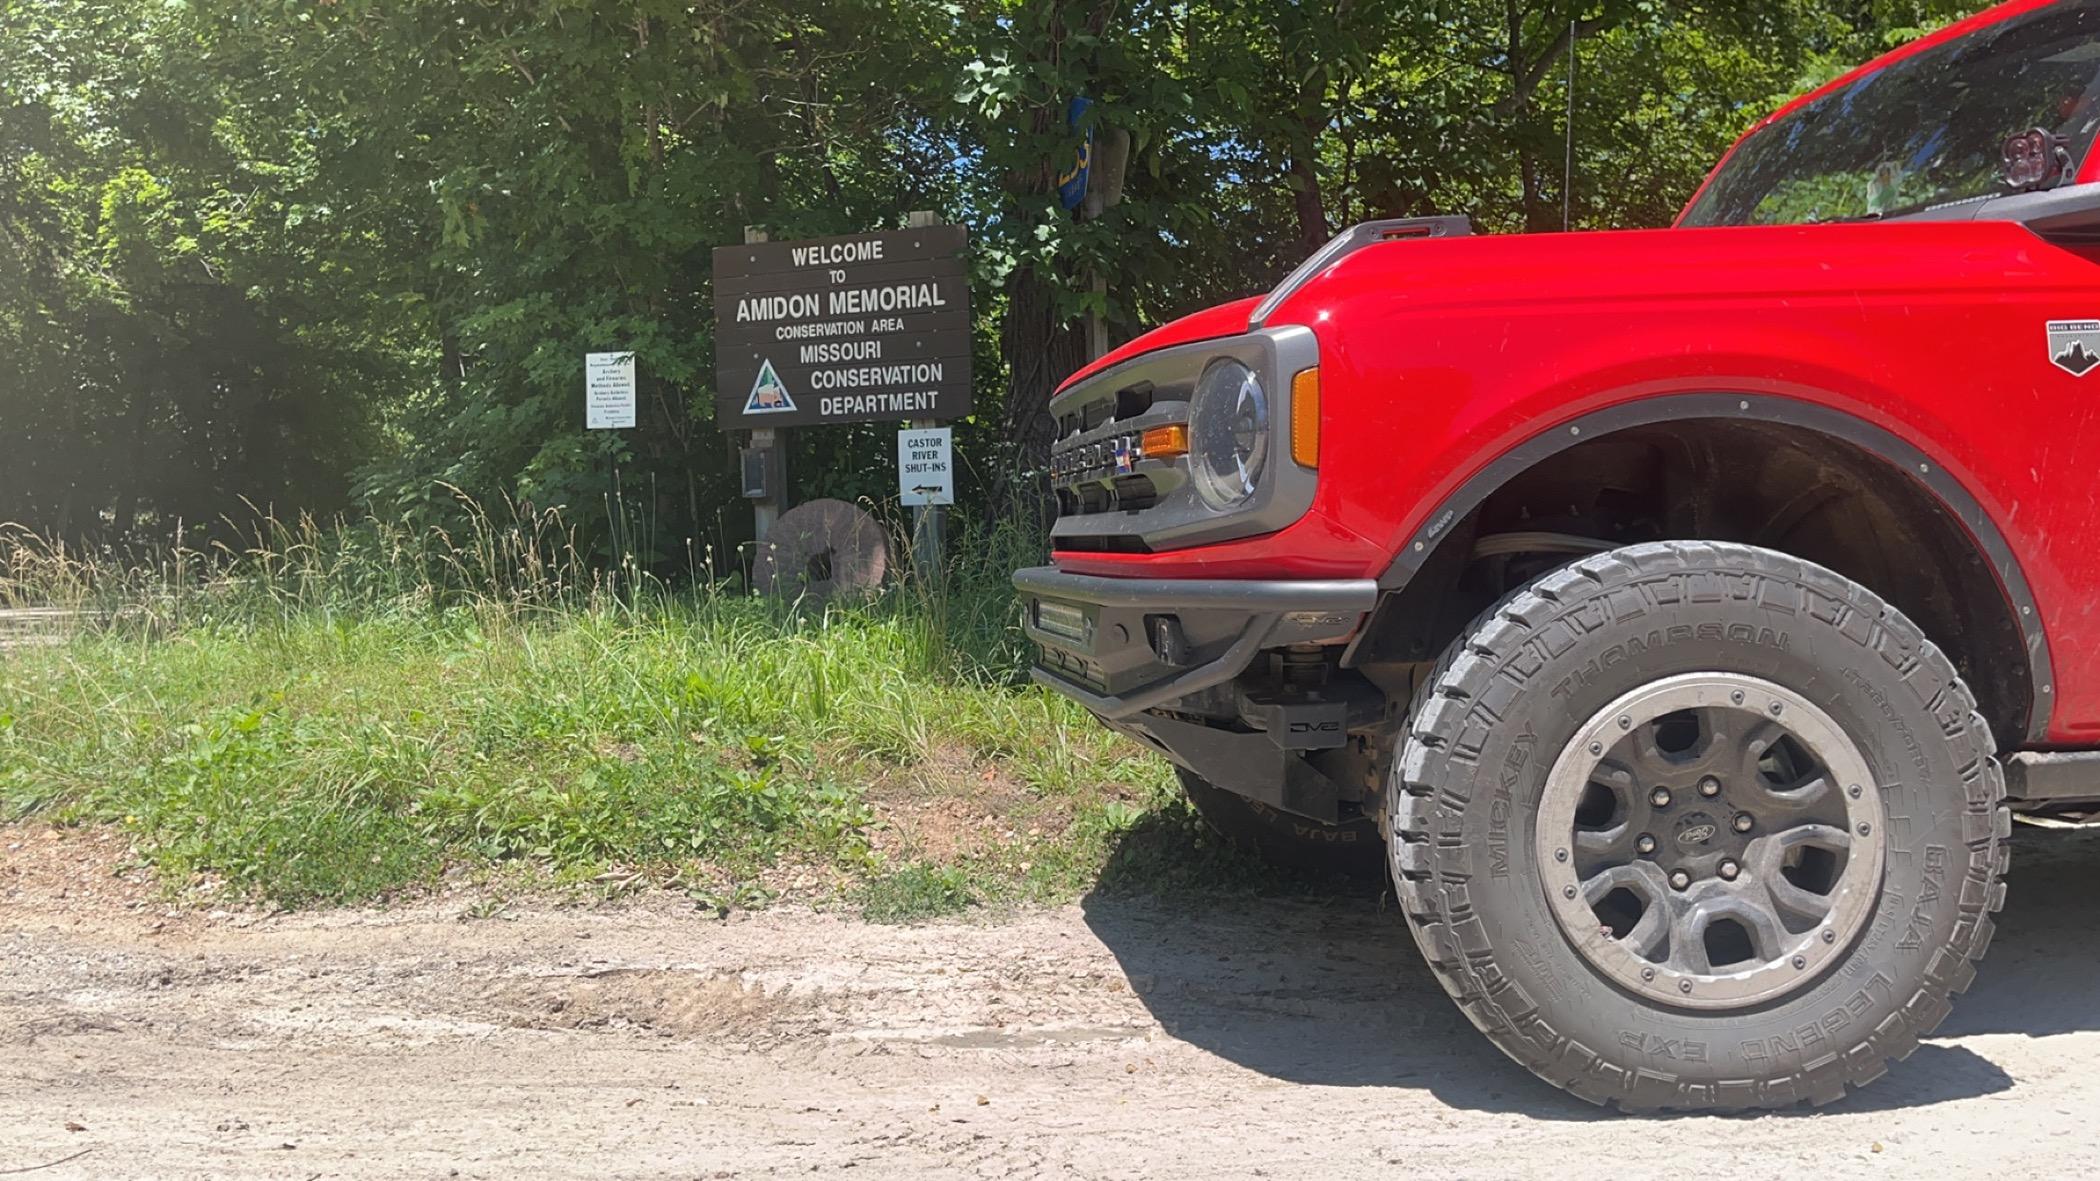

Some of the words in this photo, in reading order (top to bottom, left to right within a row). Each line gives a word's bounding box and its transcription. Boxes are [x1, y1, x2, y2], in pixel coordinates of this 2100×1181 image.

[792, 240, 883, 266] WELCOME
[829, 269, 846, 284] TO
[736, 294, 820, 322] AMIDON
[829, 283, 946, 315] MEMORIAL
[776, 320, 864, 340] CONSERVATION
[871, 318, 904, 333] AREA
[800, 340, 882, 364] MISSOURI
[811, 363, 943, 389] CONSERVATION
[820, 391, 939, 416] DEPARTMENT
[908, 438, 943, 448] CASTOR
[912, 450, 938, 460] RIVER
[905, 463, 946, 473] SHUT-INS
[1551, 622, 1791, 699] THOMPSON
[1488, 720, 1538, 880] MICKEY
[1292, 823, 1357, 842] BAJA
[1895, 844, 1949, 950] BAJA
[1738, 969, 1894, 1060] LEGEND
[1617, 1028, 1709, 1063] EXP
